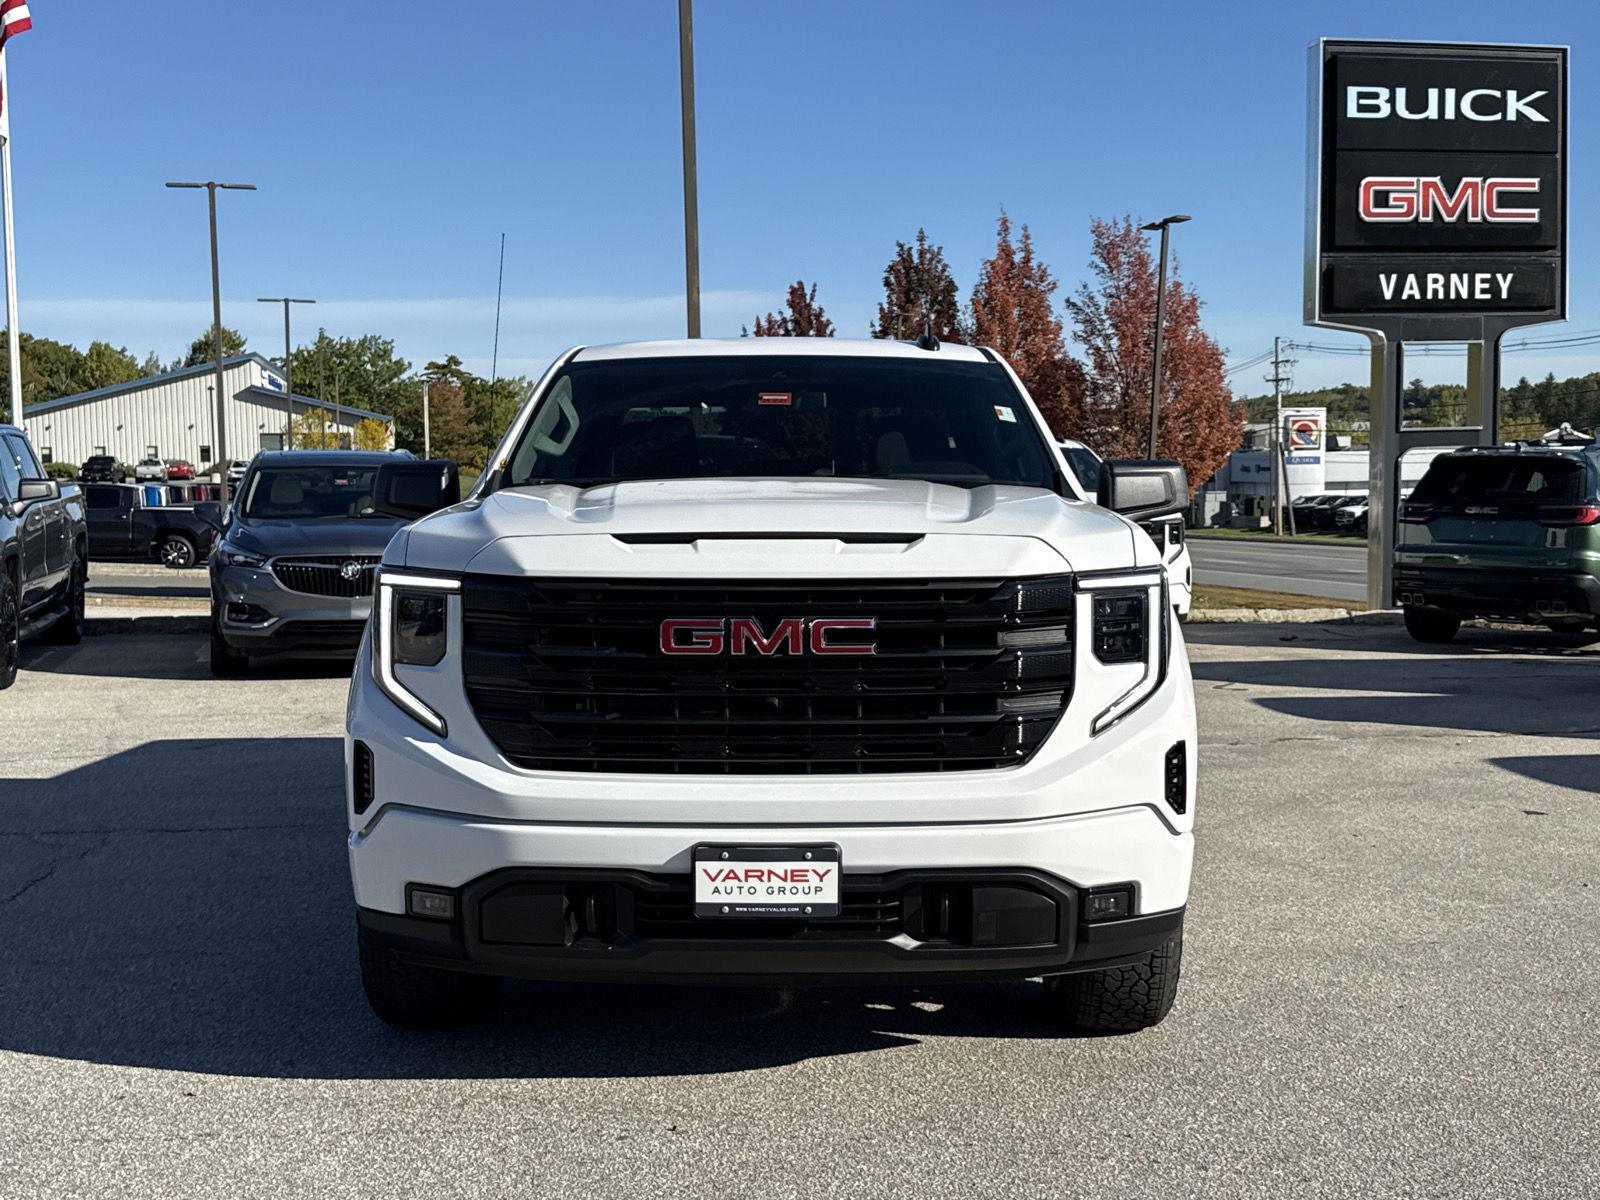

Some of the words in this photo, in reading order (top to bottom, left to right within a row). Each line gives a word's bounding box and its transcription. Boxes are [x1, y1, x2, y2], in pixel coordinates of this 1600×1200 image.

[1346, 85, 1550, 122] BUICK
[1358, 176, 1541, 222] GMC
[1379, 273, 1514, 299] VARNEY
[1465, 506, 1499, 514] GMC
[659, 616, 877, 656] GMC
[702, 868, 832, 883] VARNEY
[712, 886, 757, 895] AUTO
[766, 886, 824, 896] GROUP
